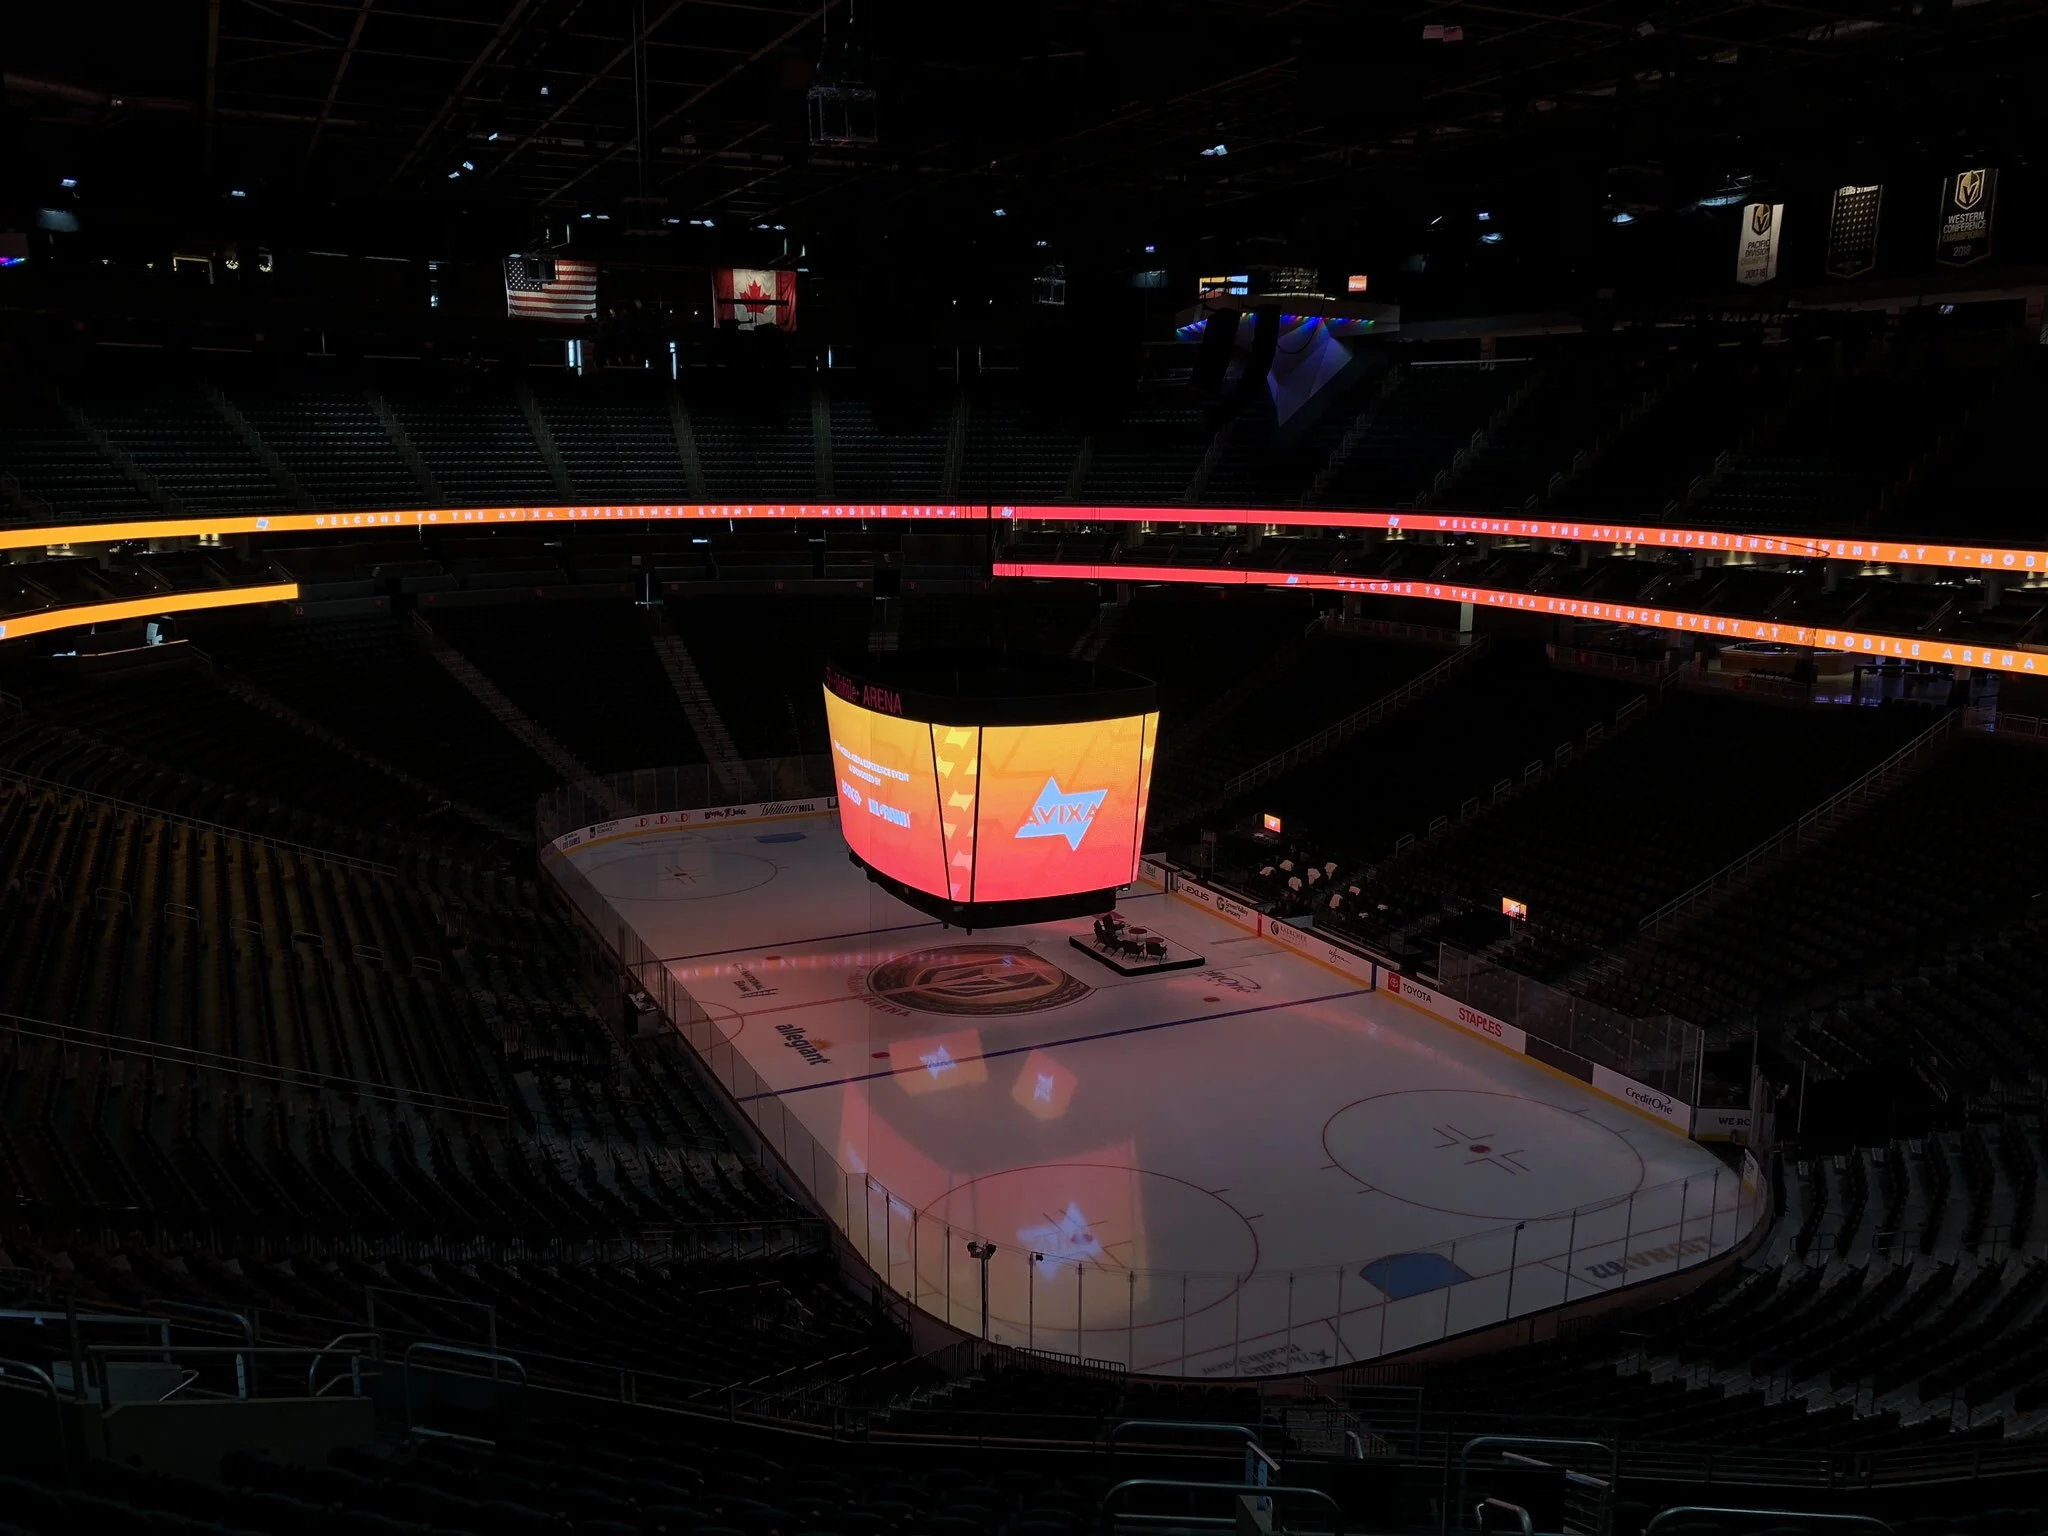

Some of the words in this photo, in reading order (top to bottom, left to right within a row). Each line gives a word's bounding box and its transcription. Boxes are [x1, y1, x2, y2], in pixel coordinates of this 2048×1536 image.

[1943, 219, 1987, 234] CONFERENCE
[1948, 211, 1985, 224] WESTERN
[316, 512, 401, 526] WELCOME
[417, 512, 437, 523] TO
[452, 511, 484, 521] THE
[499, 508, 554, 520] AVIXA
[568, 506, 684, 518] EXPERIENCE
[698, 507, 753, 517] EVENT
[768, 507, 786, 516] AT
[800, 507, 888, 516] T-MOBILE
[901, 508, 957, 518] ARENA
[1438, 518, 1510, 533] WELCOME
[1522, 523, 1539, 534] TO
[1551, 525, 1579, 537] THE
[1592, 528, 1646, 541] AVIXA
[1660, 532, 1788, 552] EXPERIENCE
[1807, 541, 1880, 558] EVENT
[1899, 548, 1926, 561] AT
[1338, 579, 1412, 594] WELCOME
[1425, 586, 1441, 597] TO
[1452, 589, 1478, 602] THE
[1489, 594, 1536, 608] AVIXA
[1548, 599, 1661, 624] EXPERIENCE
[1676, 615, 1739, 633] EVENT
[1756, 627, 1779, 639] AT
[1798, 630, 1920, 656] T-MOBILE
[1942, 649, 2035, 670] ARENA
[863, 684, 903, 716] ARENA
[1023, 804, 1098, 827] AVIXA
[1181, 883, 1209, 902] LEXUS
[1402, 982, 1432, 1004] TOYOTA
[1458, 1007, 1502, 1038] STAPLES
[775, 1024, 831, 1066] allegiant
[1718, 1116, 1735, 1126] WE
